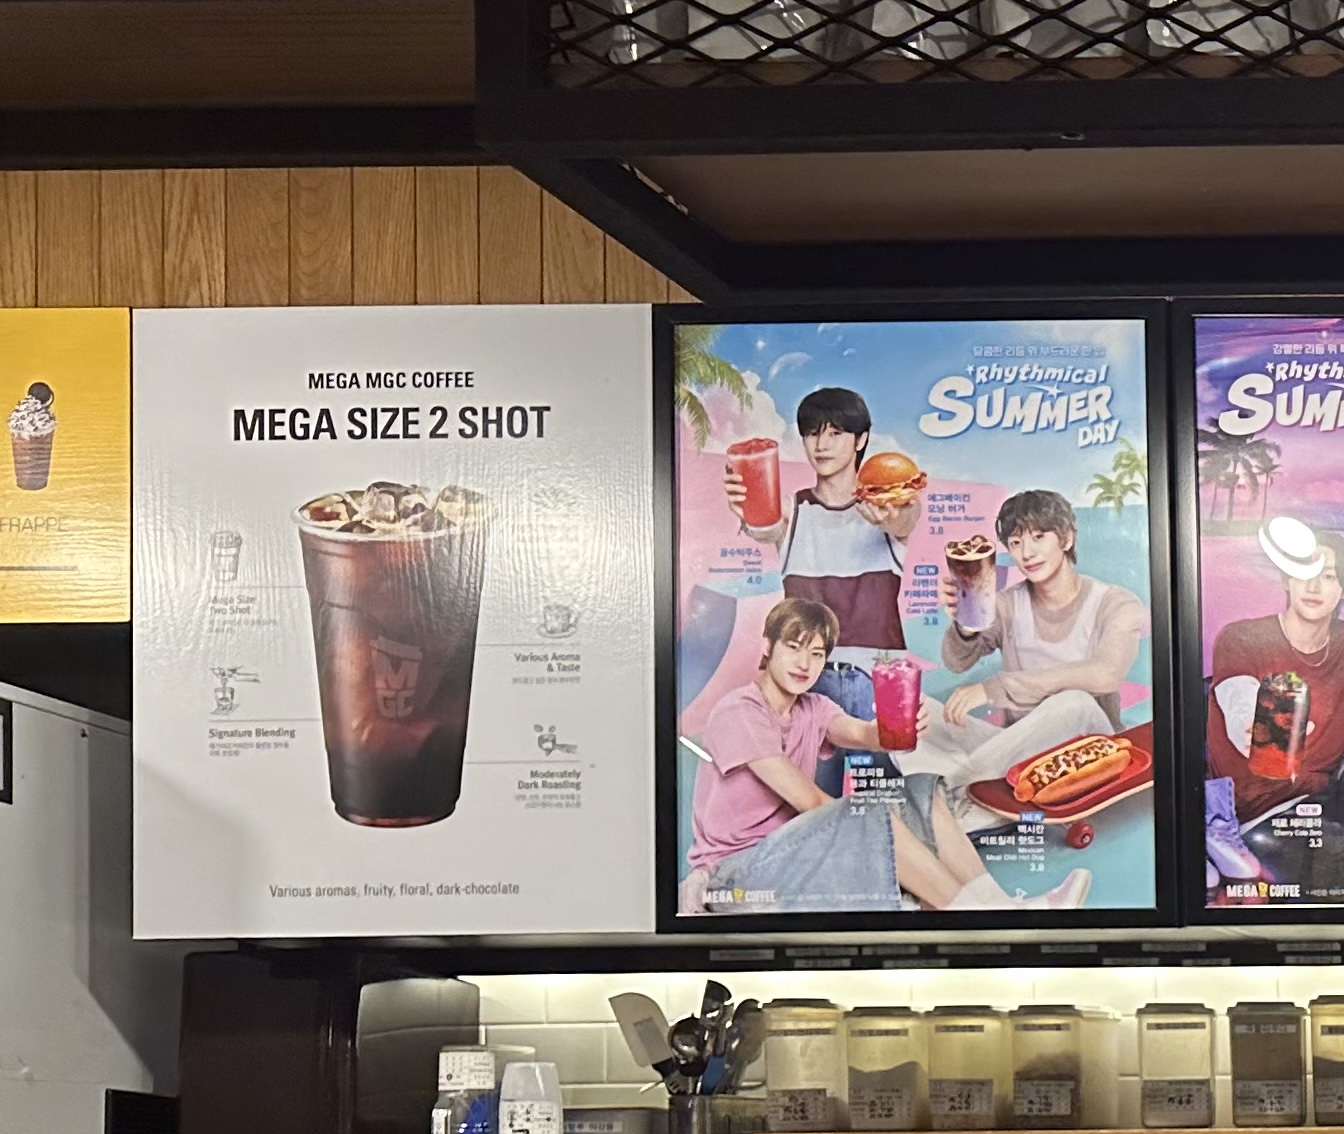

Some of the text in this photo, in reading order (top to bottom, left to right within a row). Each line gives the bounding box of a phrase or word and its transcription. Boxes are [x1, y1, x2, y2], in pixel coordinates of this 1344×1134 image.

[309, 372, 474, 389] MEGA MGC COFFEE
[976, 363, 1108, 385] Rhythmical
[919, 376, 1112, 438] SUMMER
[234, 406, 551, 441] MEGA SIZE 2 SHOT
[1078, 420, 1120, 448] DAY
[557, 662, 580, 672] Taste
[256, 728, 295, 739] Blending
[518, 780, 581, 791] Dark Roasting
[270, 885, 312, 898] Various
[436, 882, 519, 896] dark-chocolate
[1227, 885, 1258, 897] MEGA
[1270, 885, 1300, 897] COFFEE
